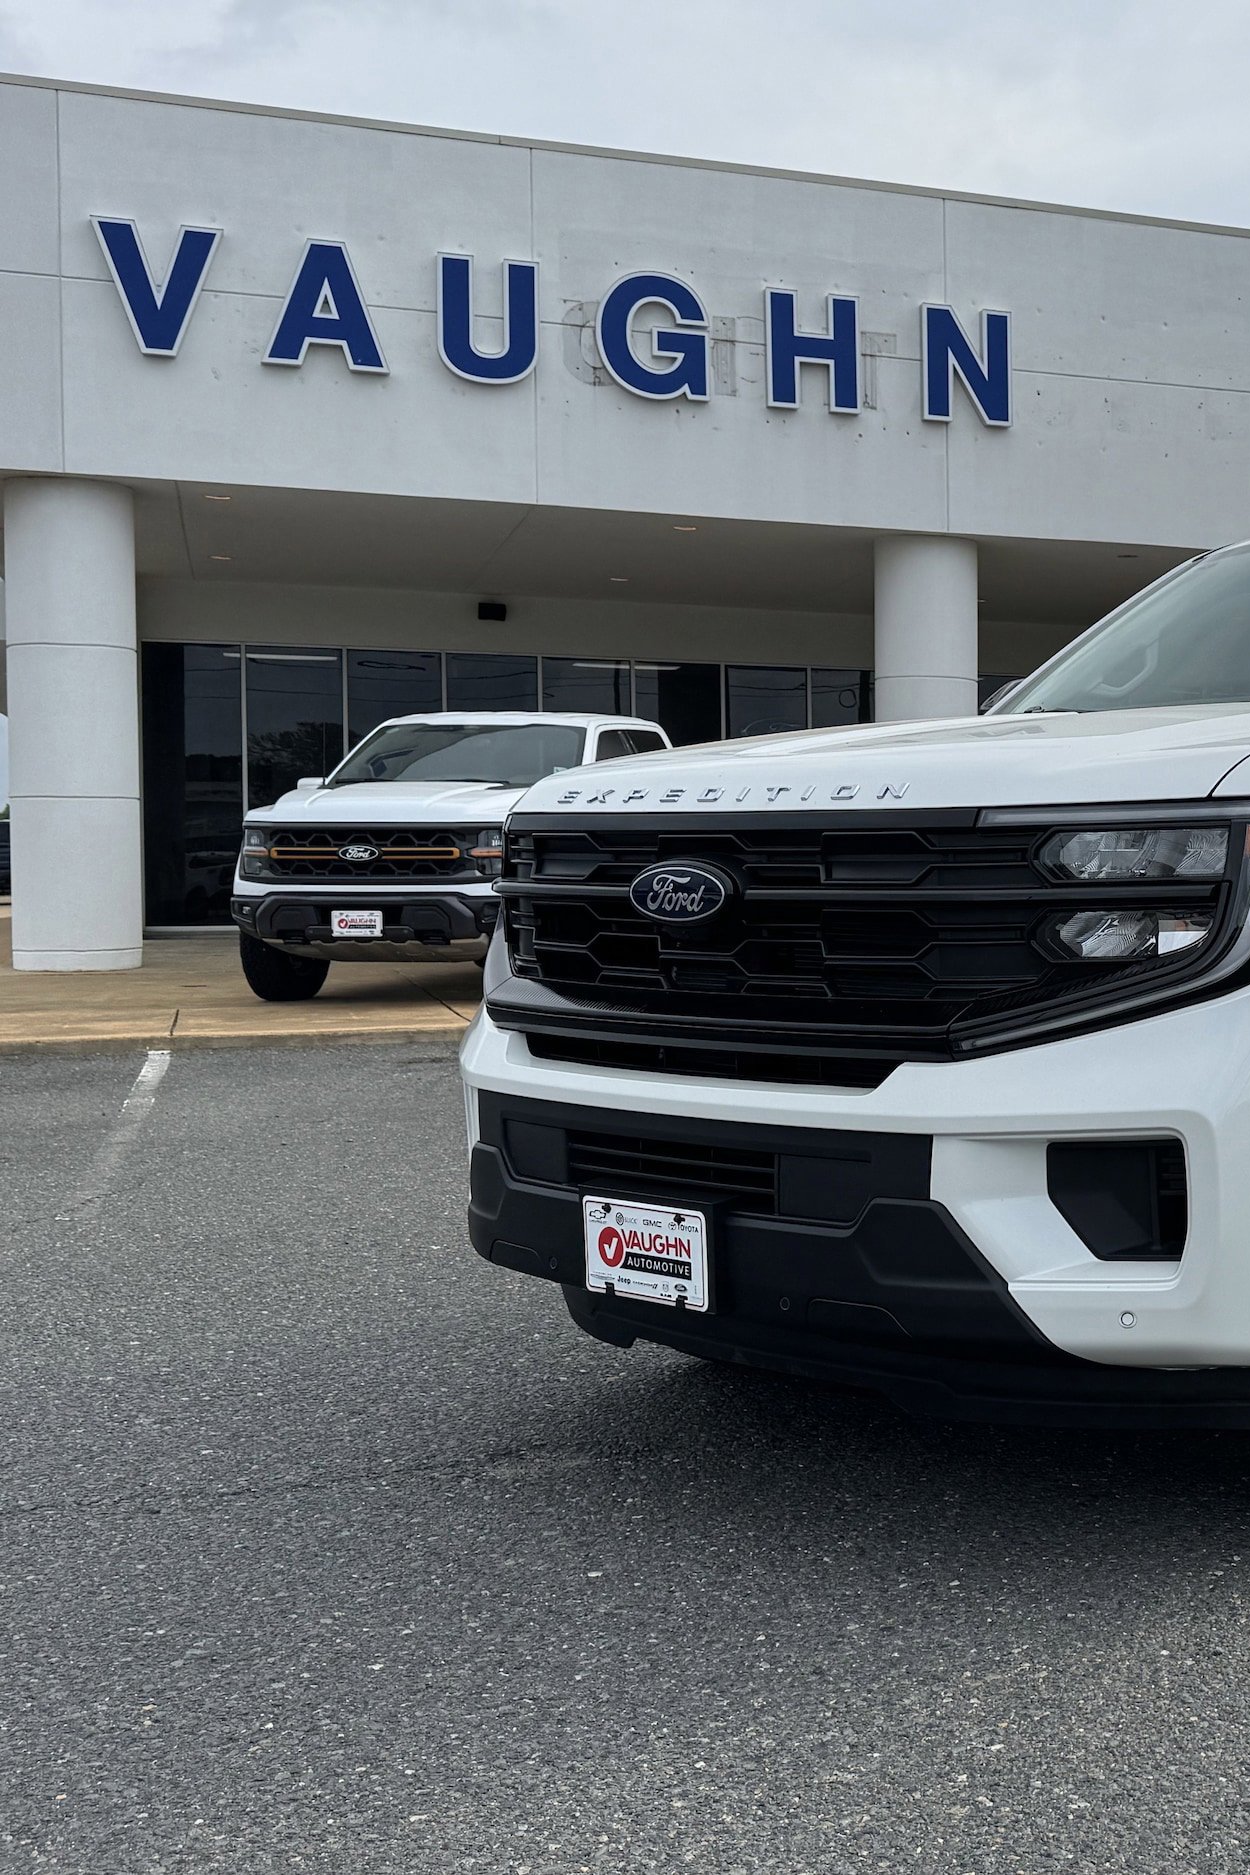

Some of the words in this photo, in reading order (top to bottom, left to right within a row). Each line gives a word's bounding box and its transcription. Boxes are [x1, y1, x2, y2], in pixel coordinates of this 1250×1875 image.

[89, 214, 1013, 429] VAUGHN
[557, 782, 912, 804] EXPEDITION
[345, 847, 371, 859] Ford
[646, 874, 705, 914] Ford
[642, 1218, 662, 1228] GMC
[621, 1228, 692, 1260] VAUGHN
[626, 1256, 691, 1277] AUTOMOTIVE
[617, 1275, 631, 1285] Jeep
